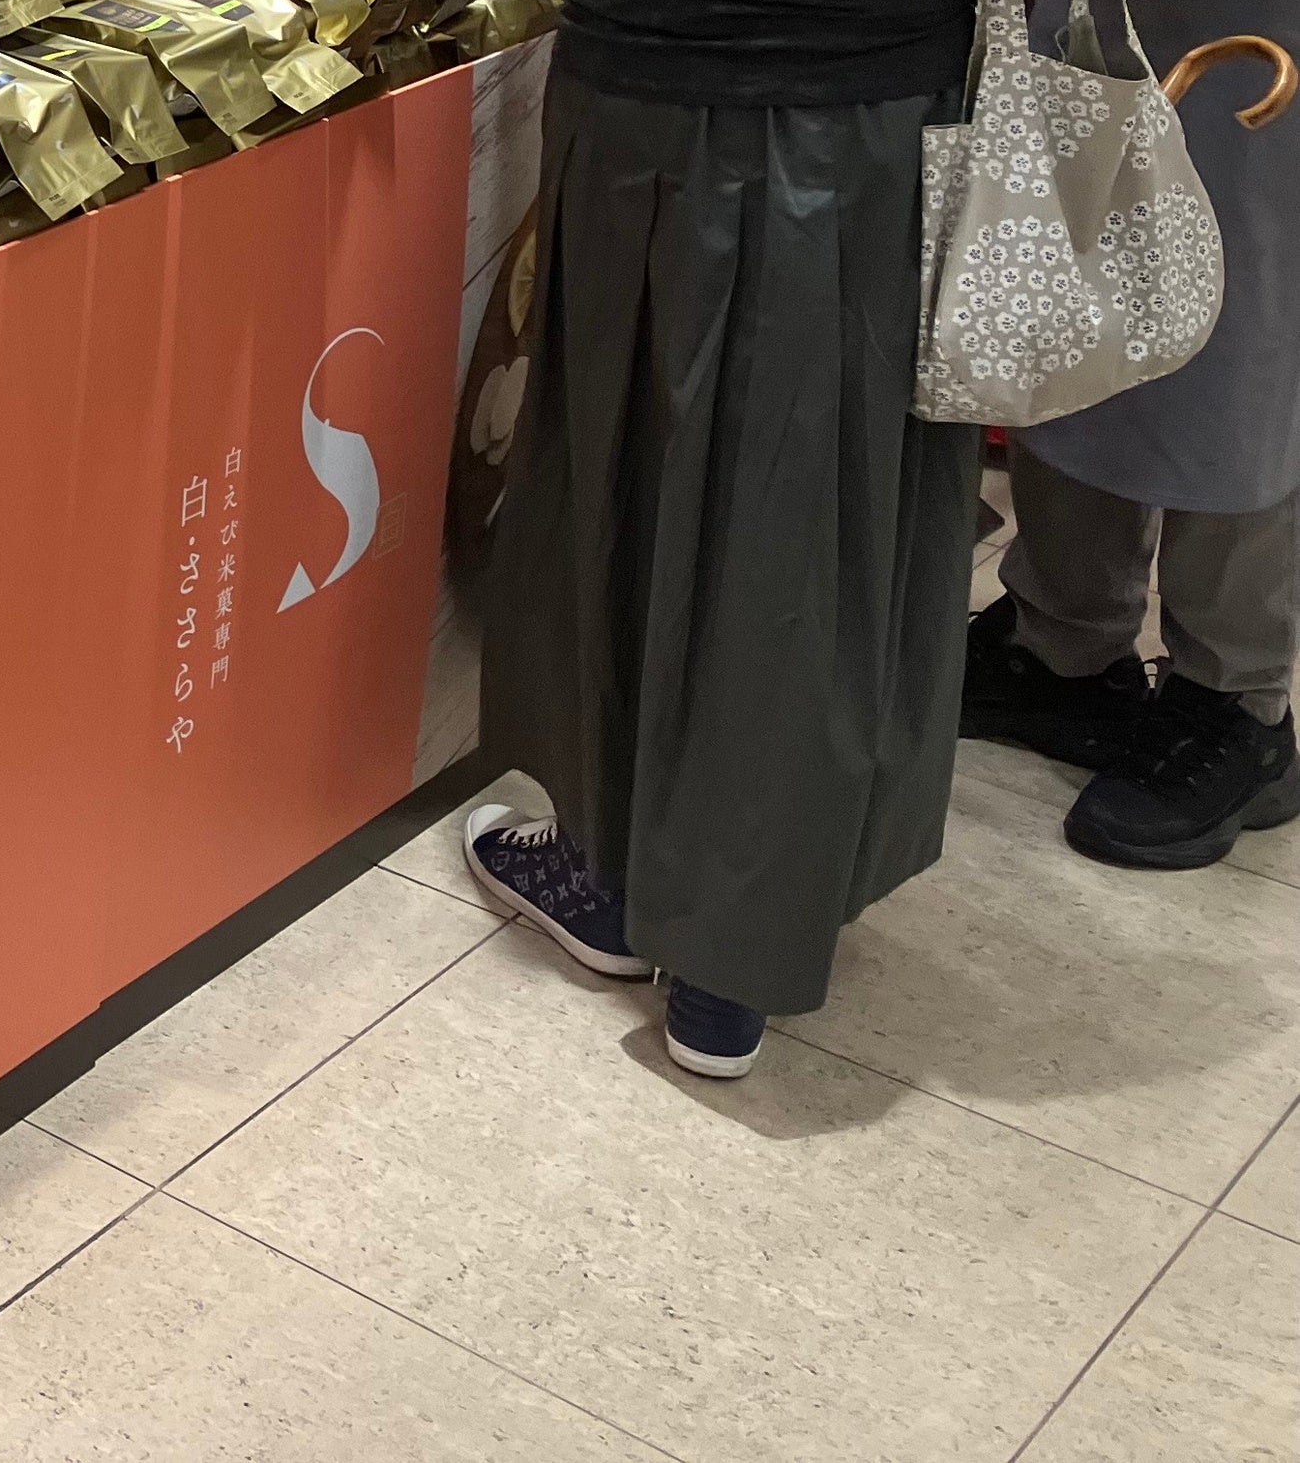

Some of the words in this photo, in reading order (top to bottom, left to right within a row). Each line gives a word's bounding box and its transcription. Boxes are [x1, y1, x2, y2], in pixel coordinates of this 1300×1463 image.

[166, 474, 208, 755] 白・ささらや
[210, 446, 244, 690] 白えび米菓専門
